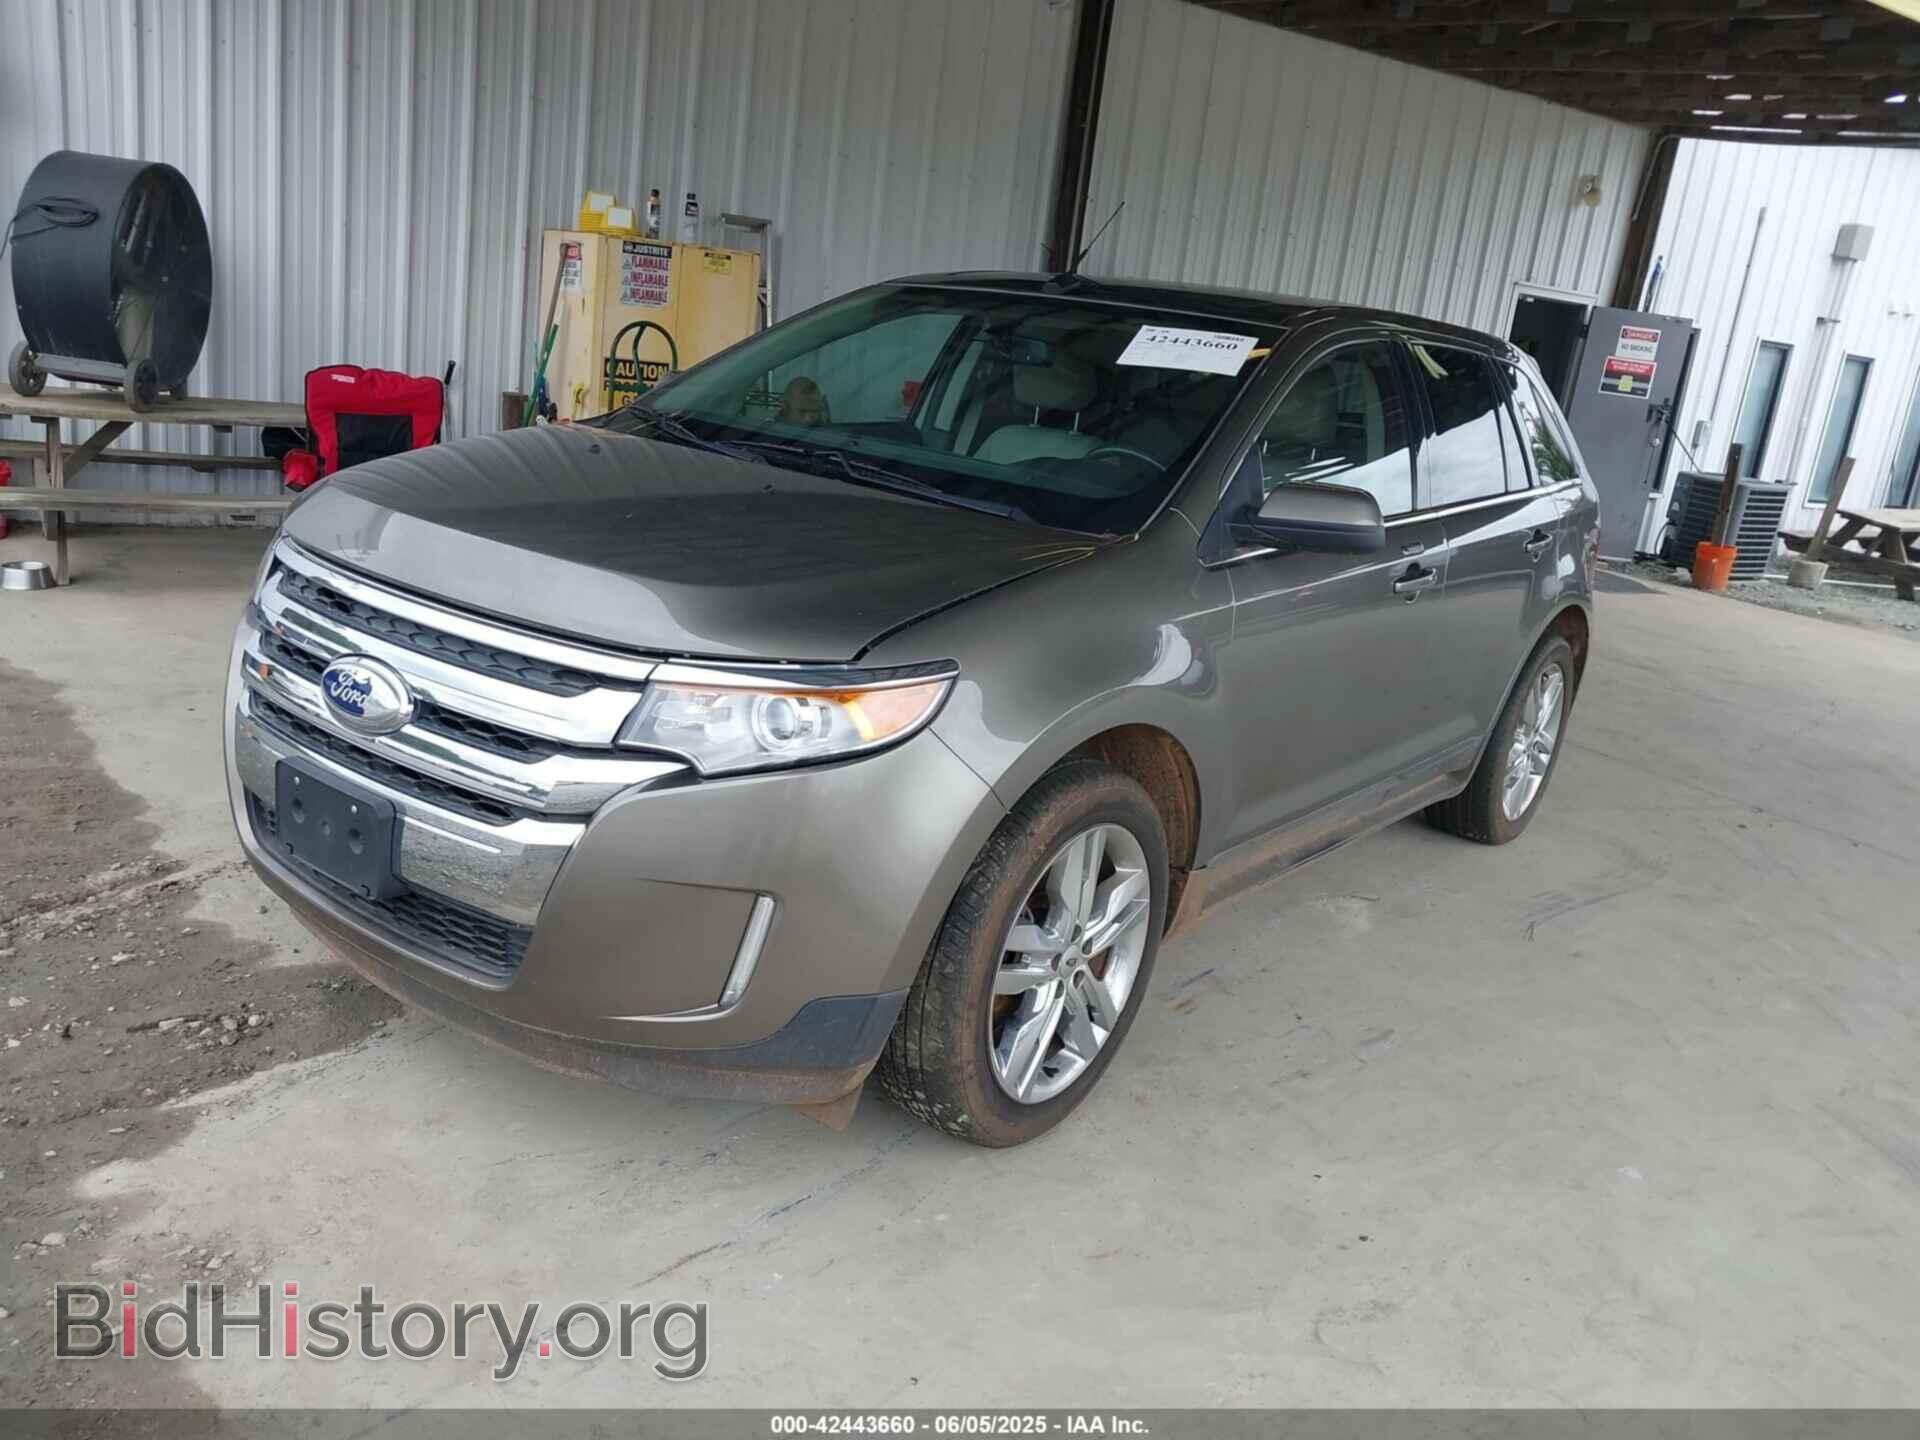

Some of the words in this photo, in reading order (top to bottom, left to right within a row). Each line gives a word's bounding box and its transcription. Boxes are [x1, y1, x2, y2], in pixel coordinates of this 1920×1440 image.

[632, 244, 669, 257] JUSTRITE
[632, 255, 669, 271] FLAMMABLE
[1145, 334, 1238, 350] 42443660
[1626, 330, 1656, 342] DANGER
[1630, 344, 1653, 353] SMOKING
[331, 671, 368, 707] Ford
